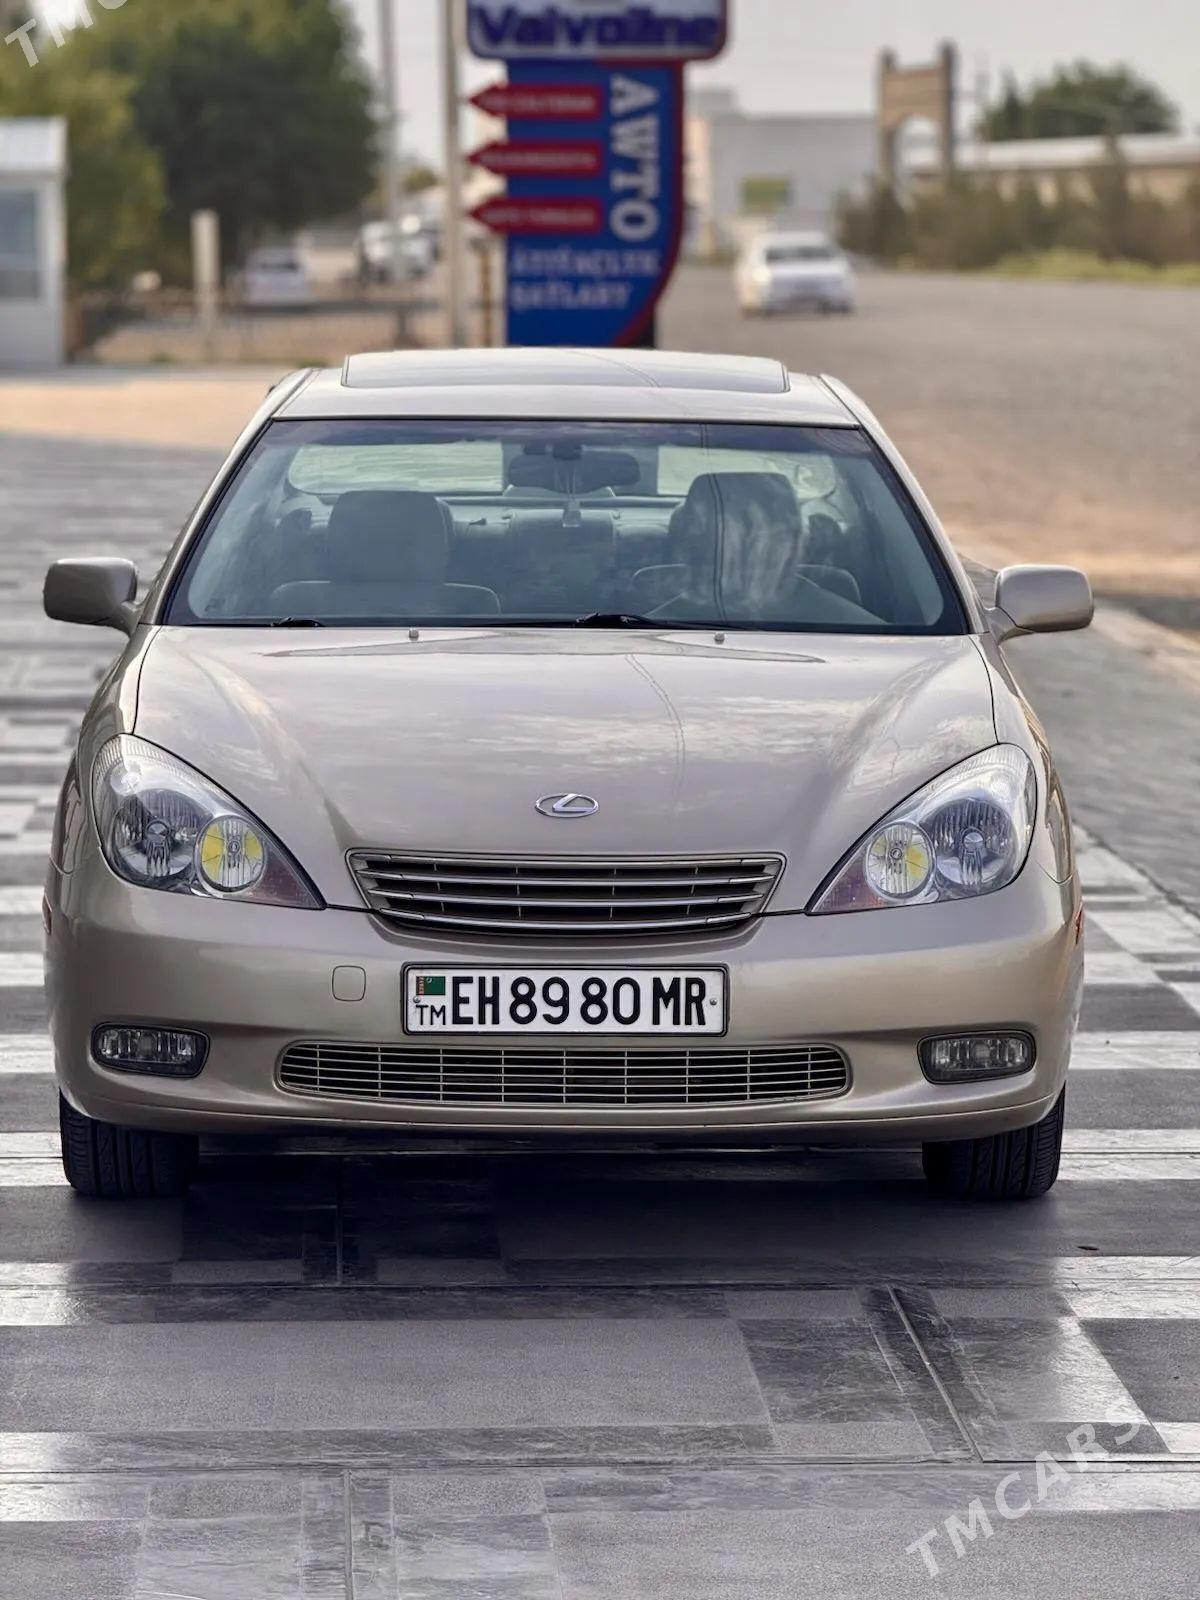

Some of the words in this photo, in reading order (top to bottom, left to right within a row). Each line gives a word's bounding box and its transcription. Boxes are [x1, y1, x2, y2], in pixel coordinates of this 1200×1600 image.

[475, 6, 718, 45] Valvoline
[609, 74, 660, 242] AWTO
[415, 1004, 446, 1026] TM
